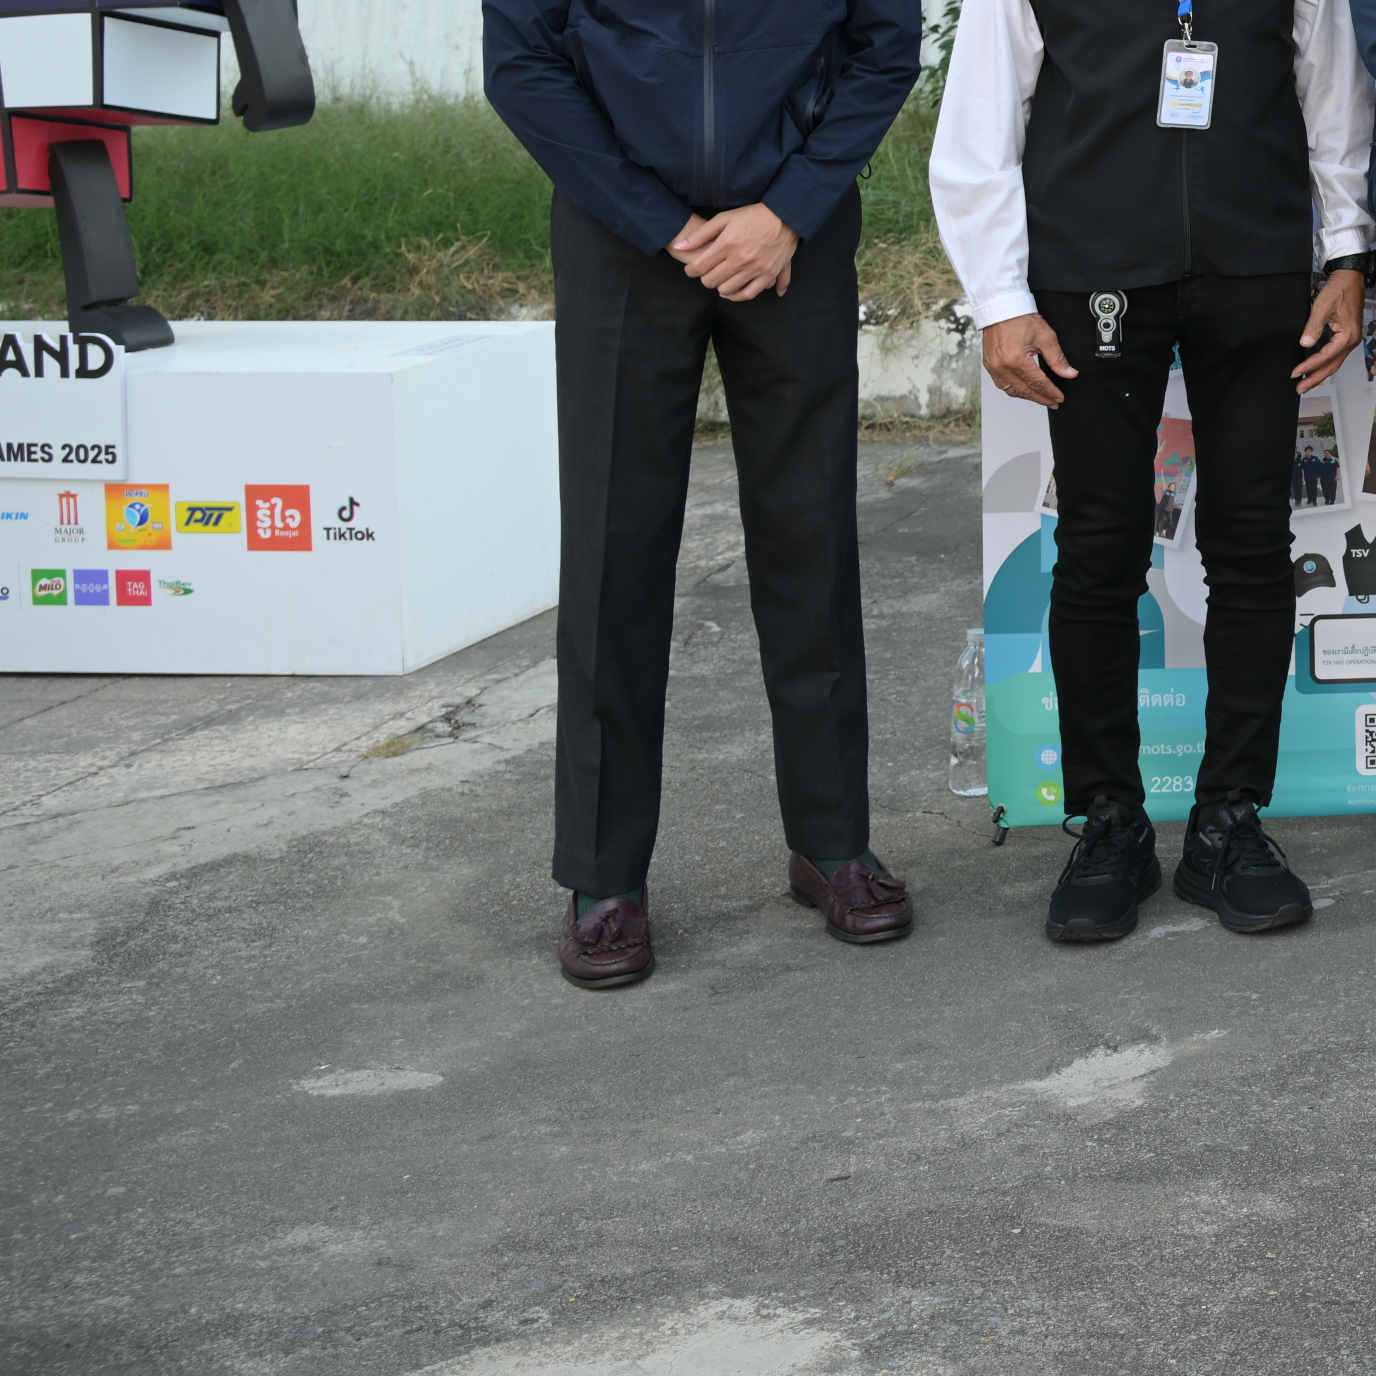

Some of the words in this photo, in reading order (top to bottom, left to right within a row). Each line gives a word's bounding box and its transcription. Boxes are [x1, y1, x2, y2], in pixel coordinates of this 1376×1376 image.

[0, 333, 115, 379] AND
[61, 443, 118, 464] 2025
[0, 512, 29, 521] IKIN
[255, 496, 302, 539] รู้ใจ
[54, 527, 85, 536] MAJOR
[275, 529, 299, 537] Roojai
[323, 527, 376, 542] TikTok
[1351, 549, 1370, 558] TSV
[38, 581, 62, 593] MILO
[127, 581, 145, 589] TAG
[158, 579, 192, 587] ThaiBev
[1139, 740, 1206, 757] mots.go.t
[1150, 776, 1194, 793] 2283
